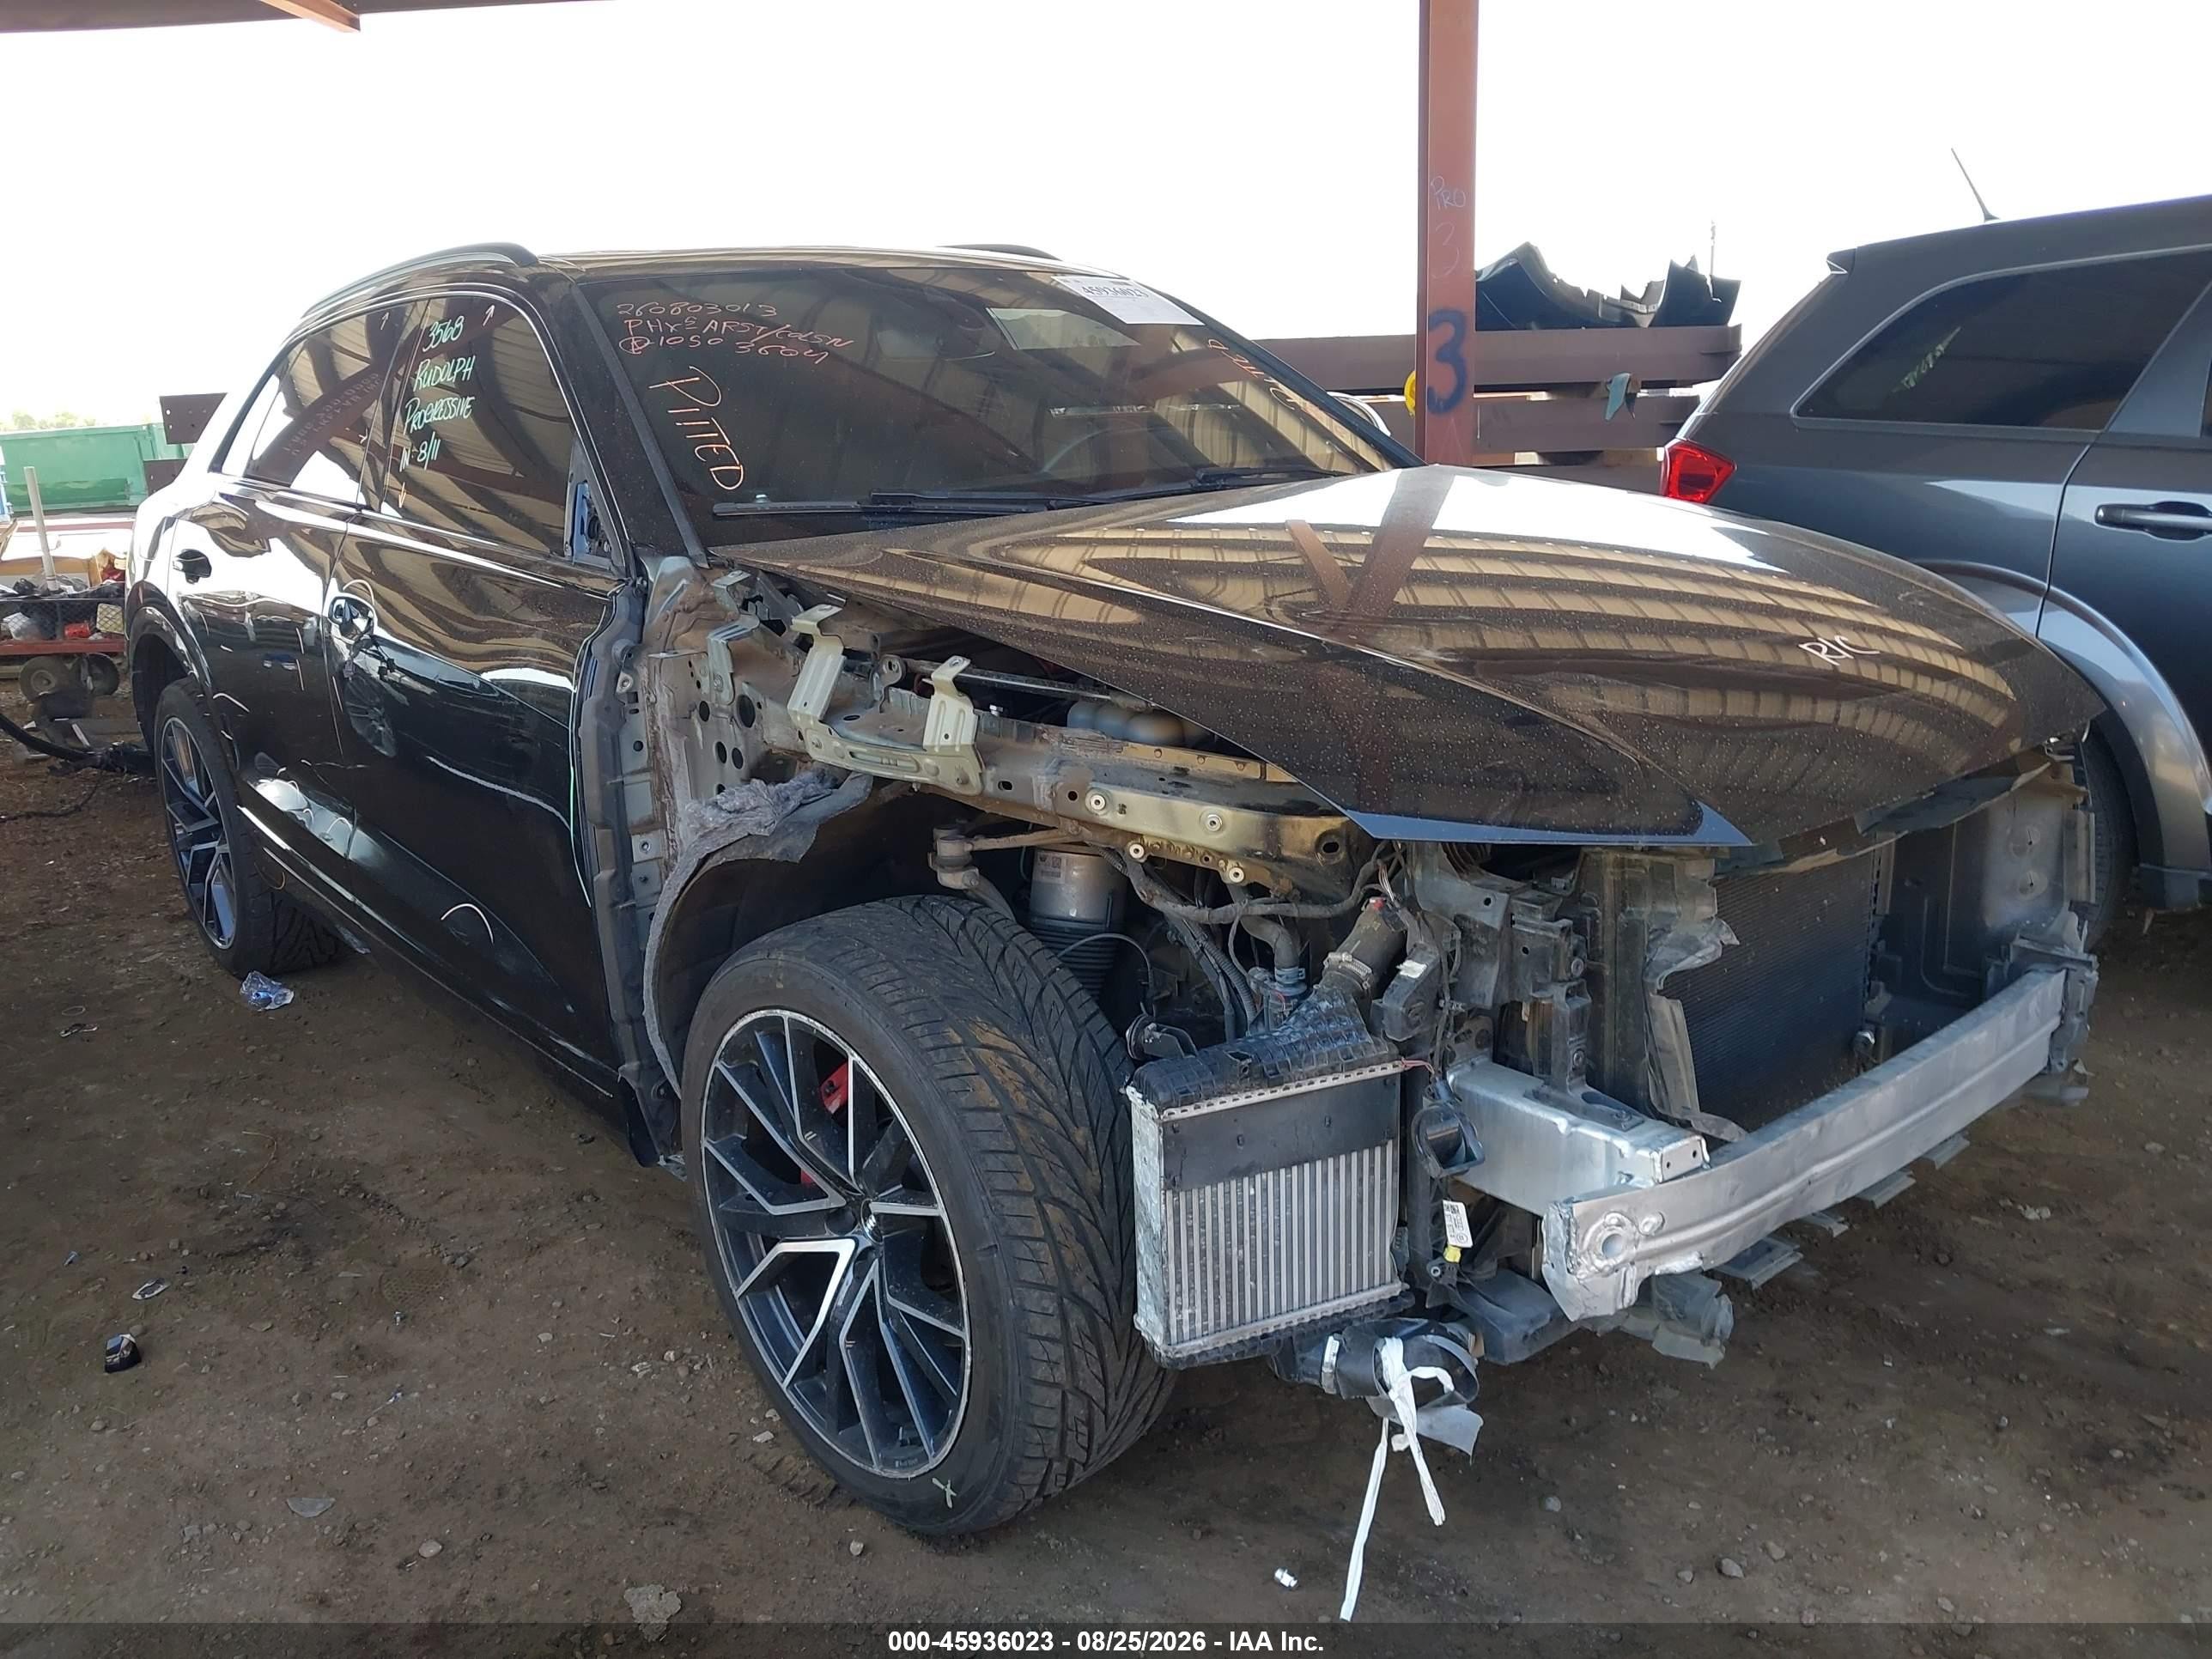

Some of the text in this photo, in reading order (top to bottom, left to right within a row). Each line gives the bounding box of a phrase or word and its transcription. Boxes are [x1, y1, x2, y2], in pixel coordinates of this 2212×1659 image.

[617, 302, 778, 317] 260803013
[422, 315, 465, 352] 3568
[412, 356, 476, 392] RUDOLPH
[1427, 307, 1468, 415] 3
[403, 396, 476, 436] PROGRESSIVE
[648, 365, 744, 490] PITTED
